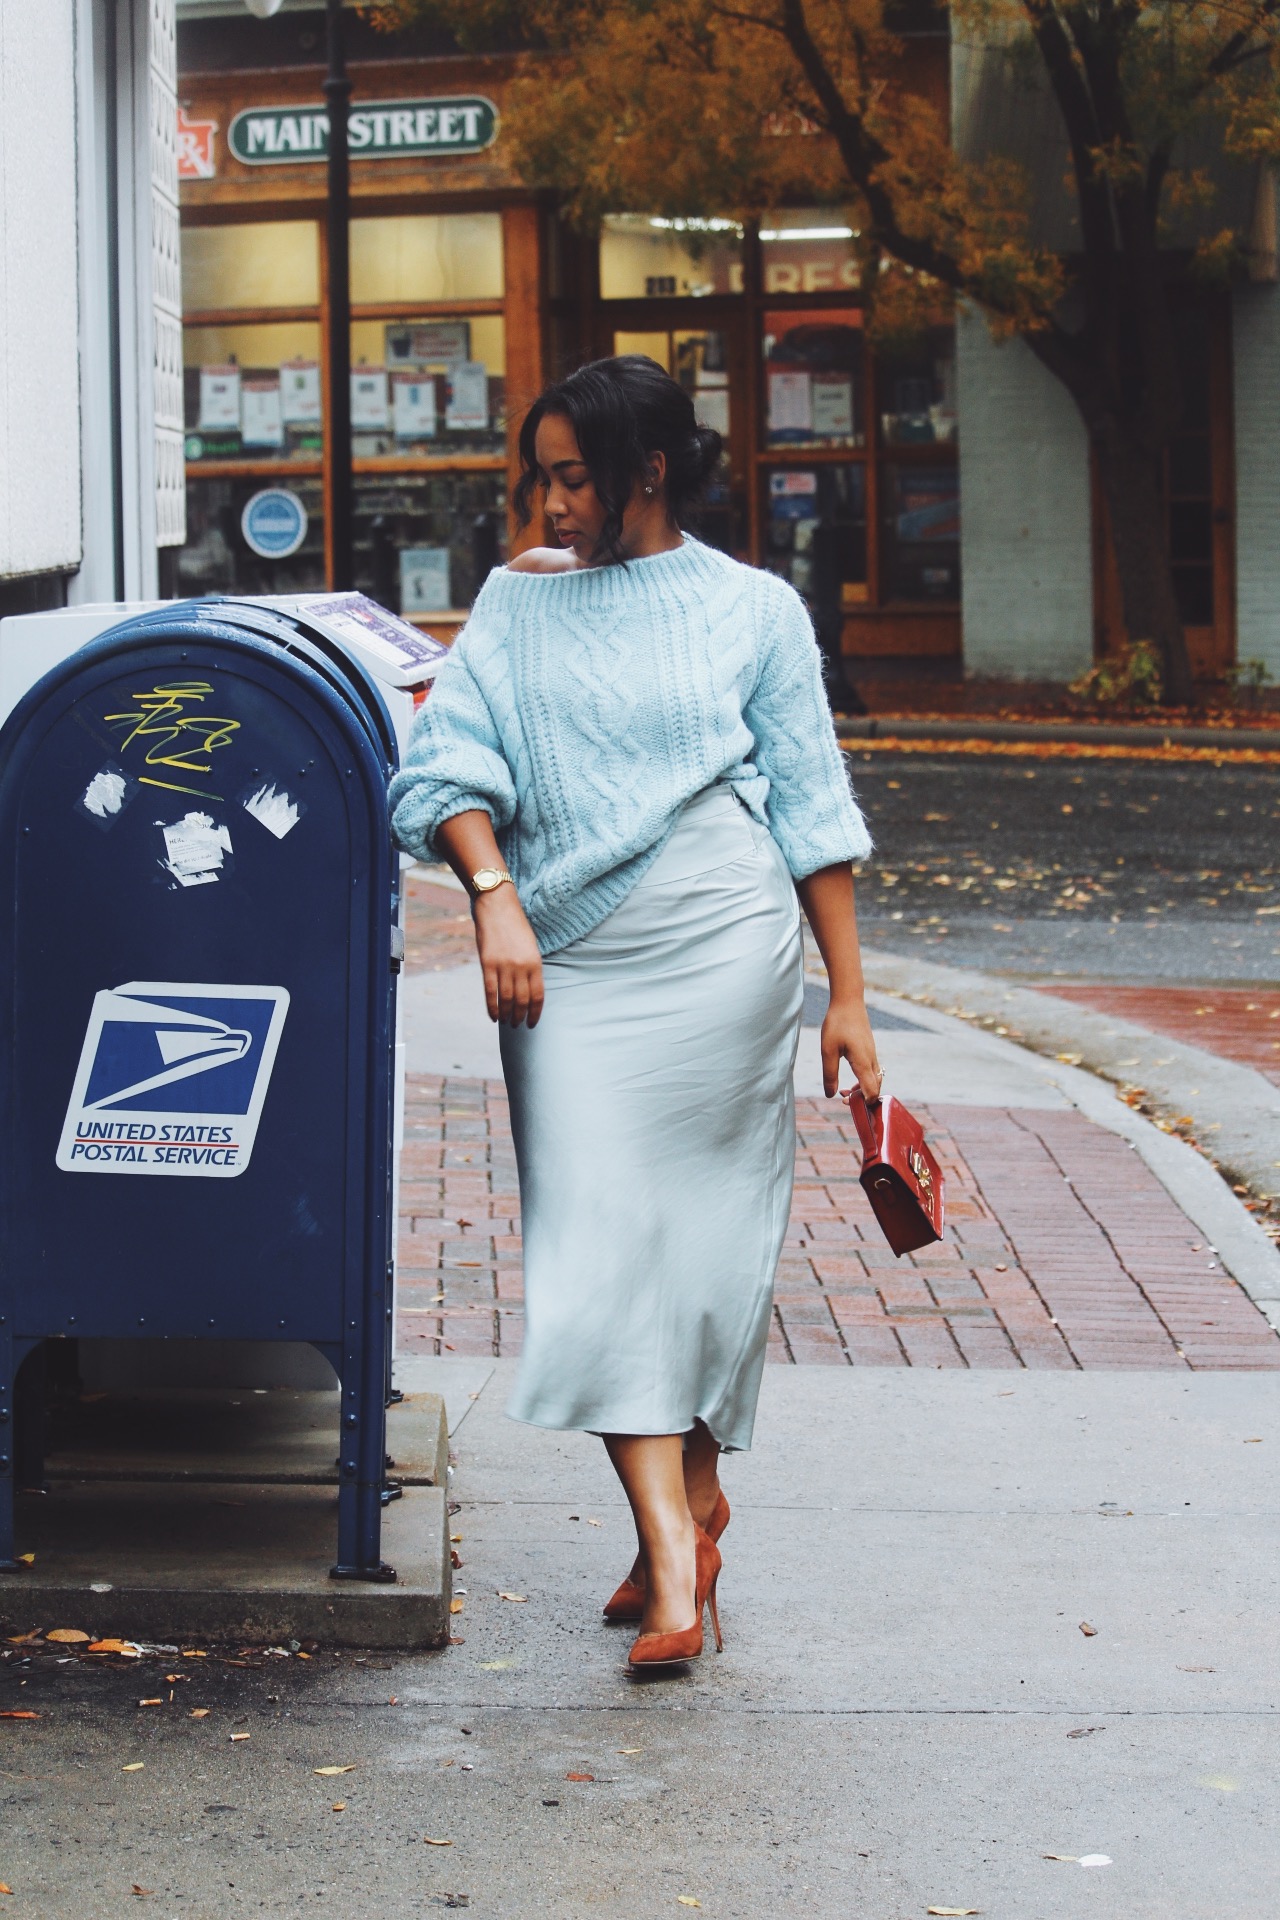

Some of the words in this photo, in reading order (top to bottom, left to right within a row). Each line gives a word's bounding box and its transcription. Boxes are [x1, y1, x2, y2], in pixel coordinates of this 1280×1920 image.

[346, 106, 483, 147] STREET
[76, 1121, 157, 1140] UNITED
[159, 1124, 233, 1143] STATES
[70, 1143, 149, 1163] POSTAL
[152, 1147, 239, 1166] SERVICE
